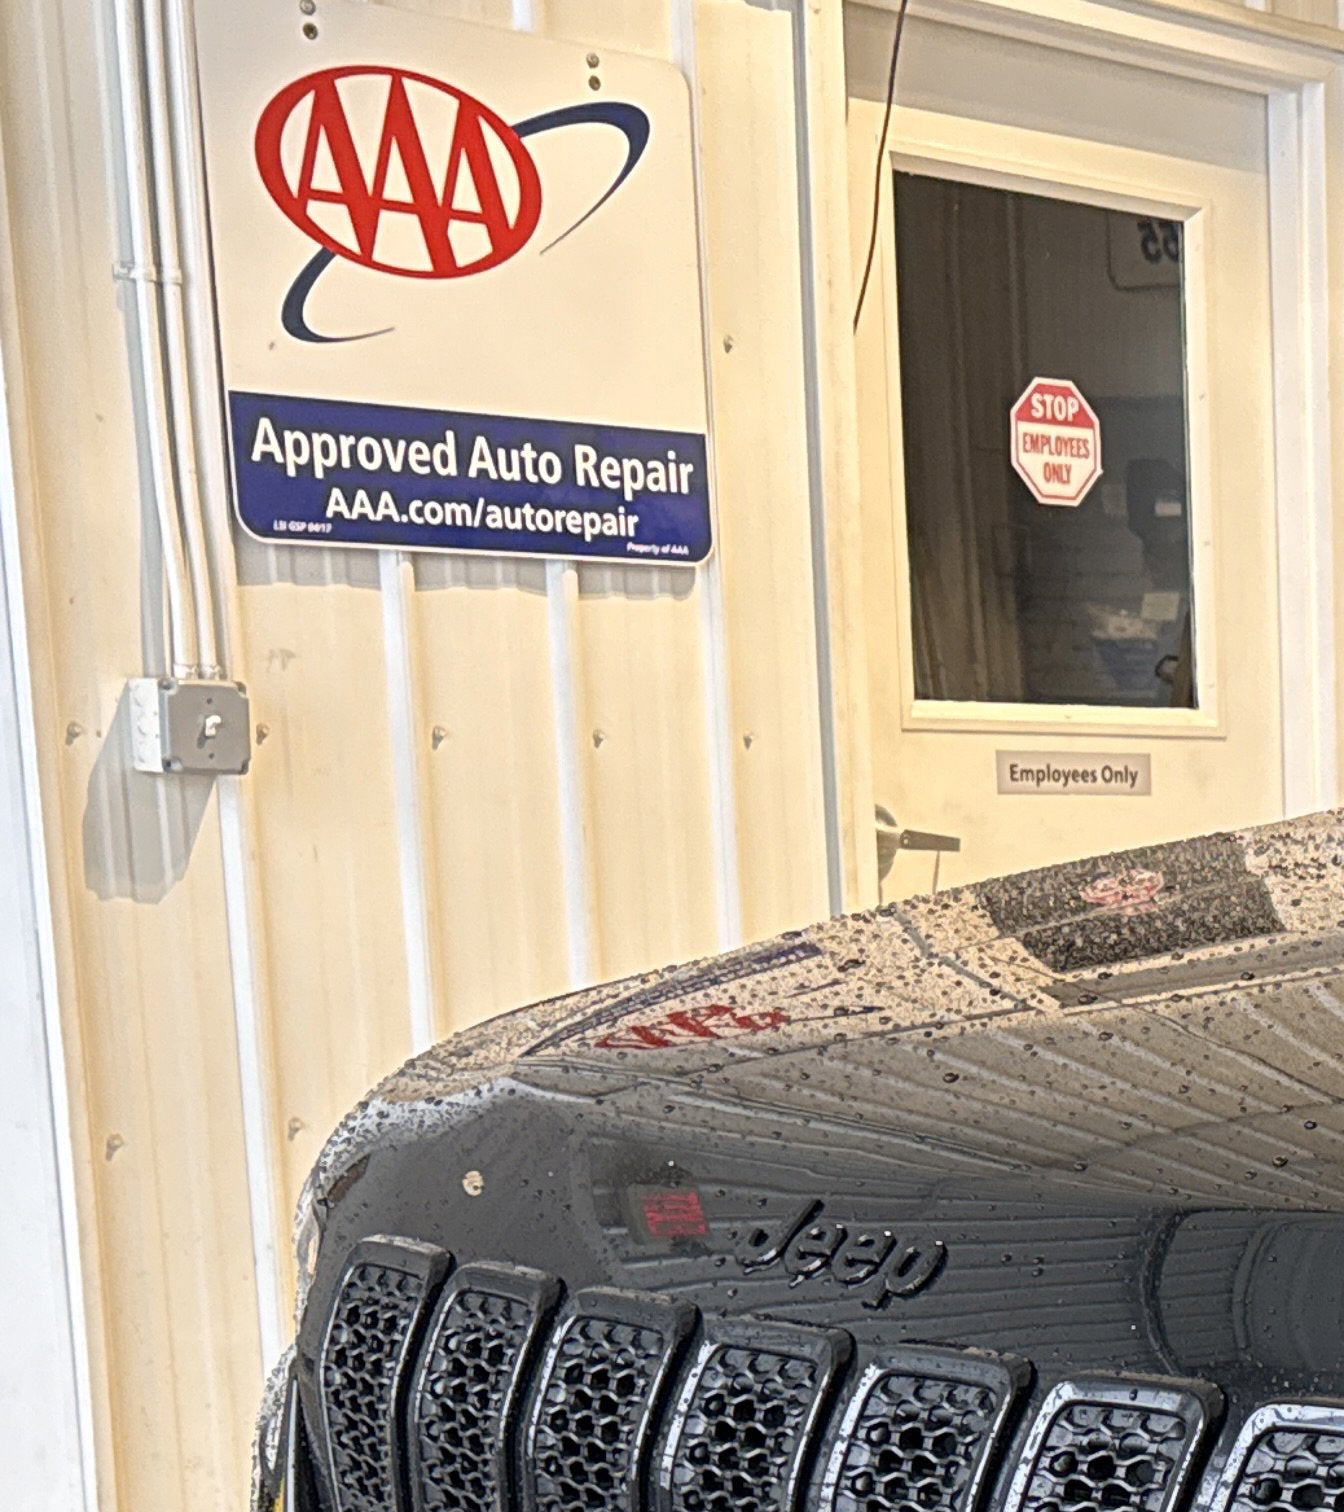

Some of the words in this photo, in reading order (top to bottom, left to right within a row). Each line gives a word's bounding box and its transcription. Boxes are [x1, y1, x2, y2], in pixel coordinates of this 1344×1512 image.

[268, 66, 532, 278] AAA
[1031, 393, 1079, 422] STOP
[251, 417, 458, 479] Approved
[468, 436, 562, 484] Auto
[574, 444, 693, 501] Repair
[1023, 432, 1090, 459] EMPLOYEES
[1043, 462, 1072, 485] ONLY
[326, 487, 639, 542] AAA.com/autorepair
[661, 543, 671, 554] of
[1009, 763, 1098, 788] Employees
[1101, 765, 1138, 788] Only
[735, 1199, 949, 1311] Jeep
